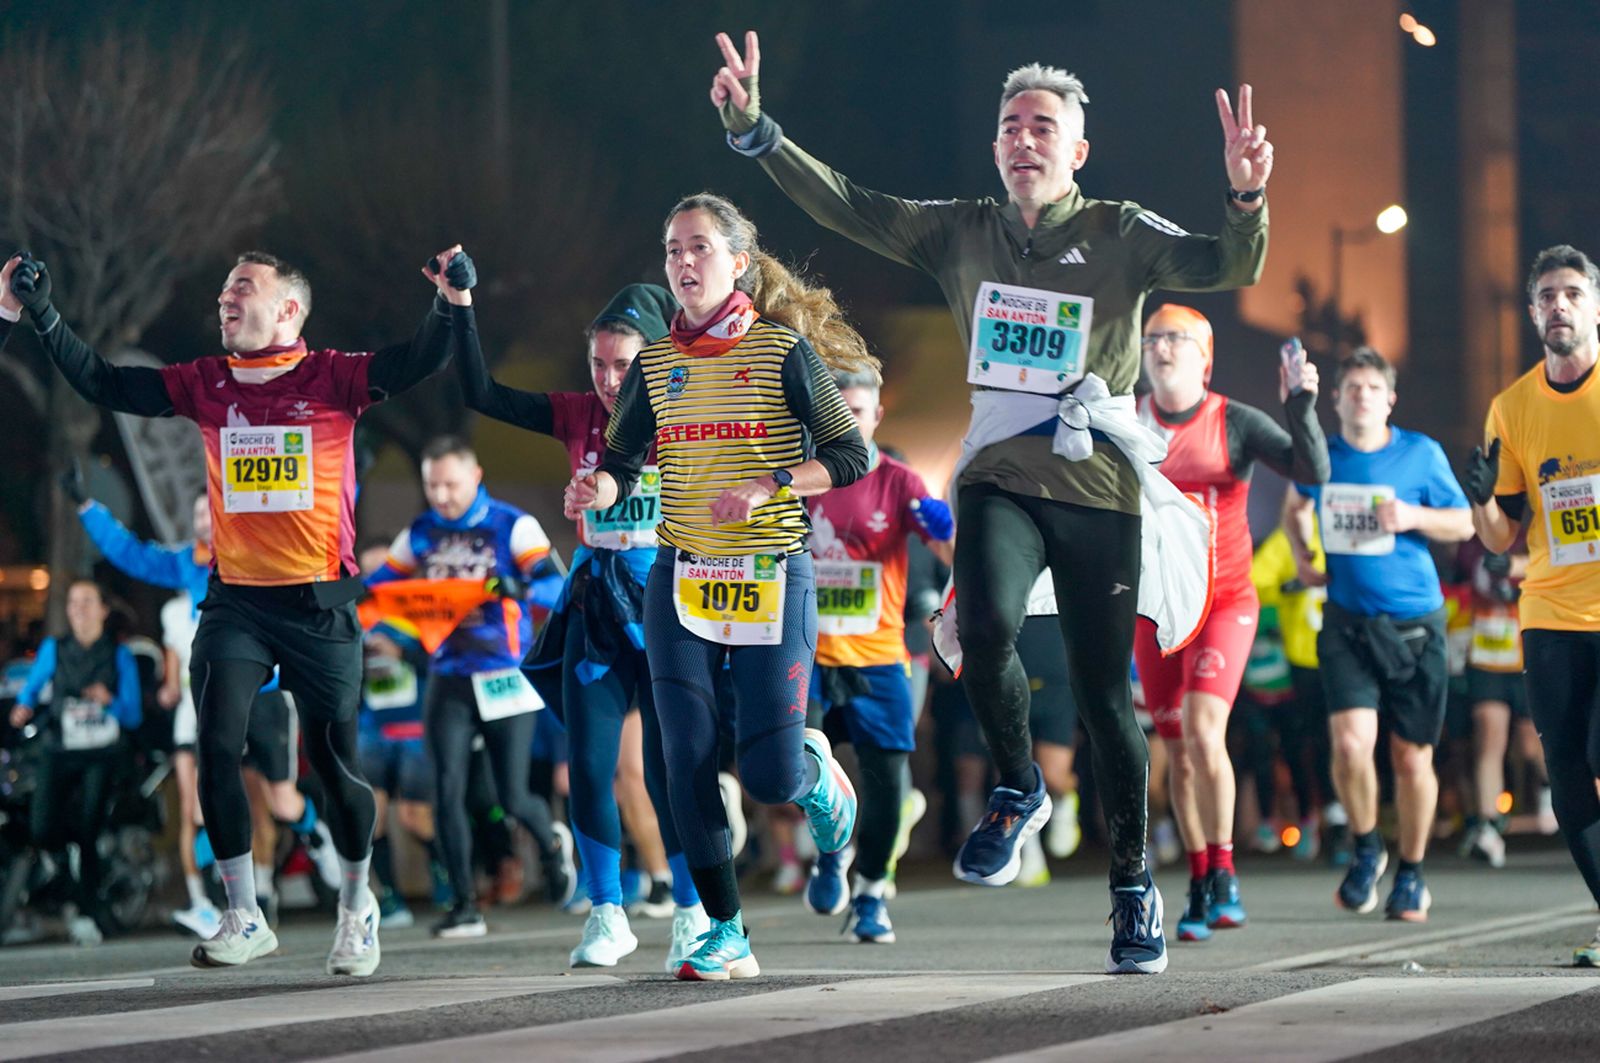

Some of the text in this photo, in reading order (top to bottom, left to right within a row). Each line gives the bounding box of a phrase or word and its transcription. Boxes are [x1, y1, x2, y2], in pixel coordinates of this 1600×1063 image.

[1002, 298, 1047, 312] NOCHE DE
[986, 307, 1008, 319] SAN
[992, 321, 1066, 360] 3309
[239, 435, 275, 445] NOCHE DE
[230, 447, 246, 456] SAN
[233, 456, 298, 483] 12979
[1559, 488, 1582, 498] NOCHE
[1552, 500, 1568, 511] SAN
[700, 557, 744, 568] NOCHE DE
[688, 567, 708, 579] SAN
[699, 581, 759, 612] 1075
